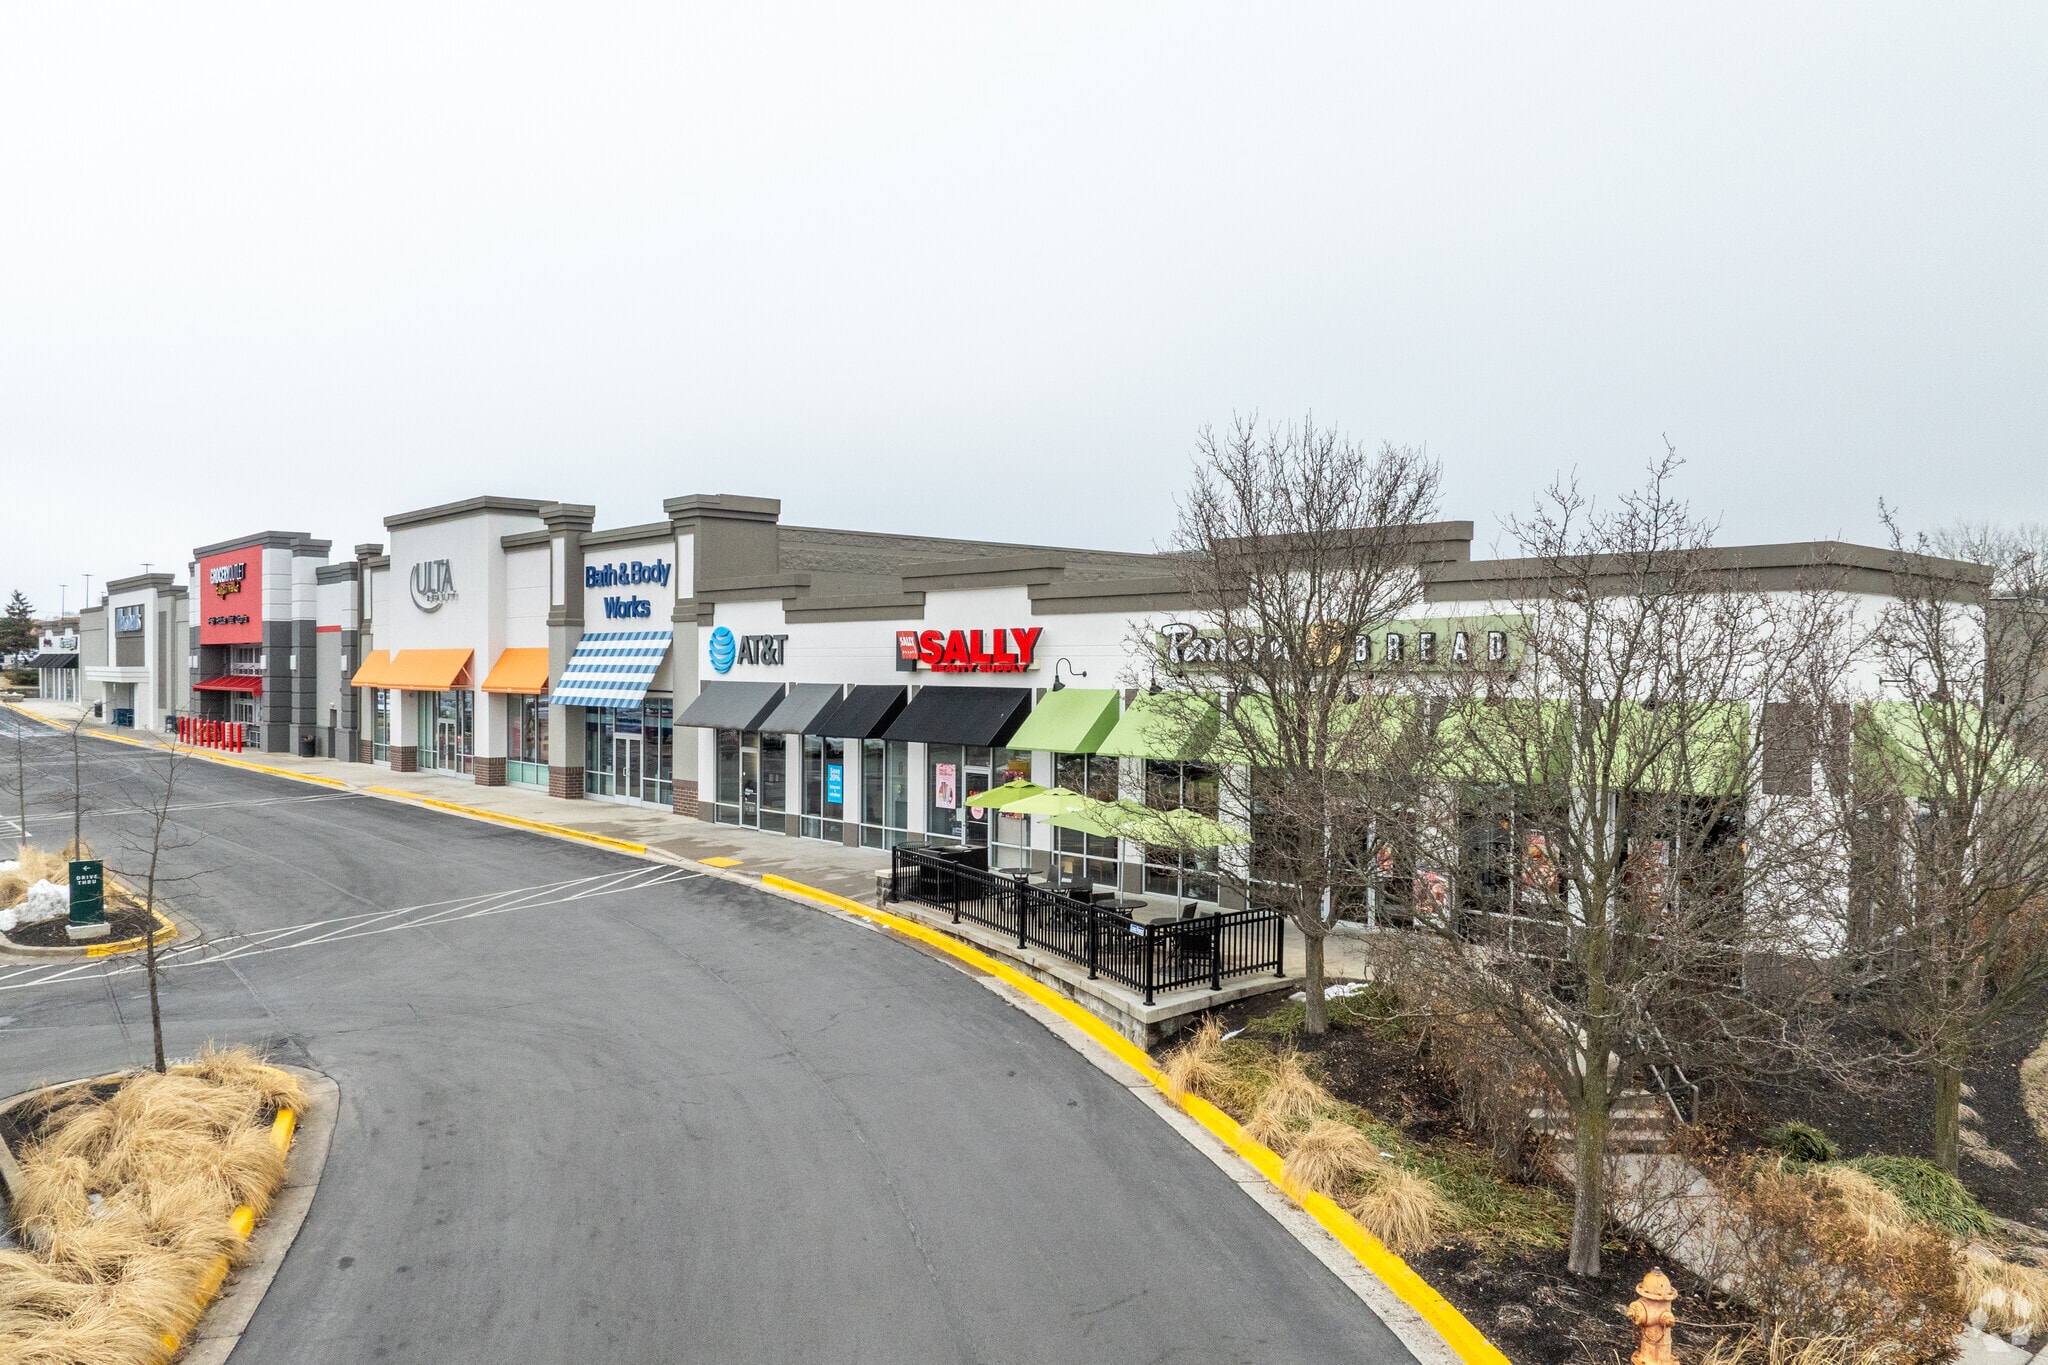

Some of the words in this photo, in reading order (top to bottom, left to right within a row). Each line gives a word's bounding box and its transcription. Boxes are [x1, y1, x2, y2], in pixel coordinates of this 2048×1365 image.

[415, 559, 454, 595] ULTA
[586, 563, 617, 587] Bath
[618, 562, 631, 585] &
[631, 559, 672, 587] Body
[603, 595, 651, 619] Works
[737, 634, 788, 665] AT&T
[919, 627, 1043, 665] SALLY
[1355, 631, 1507, 662] BREAD
[931, 664, 978, 673] BEAUTY
[979, 664, 1030, 673] SUPPLY
